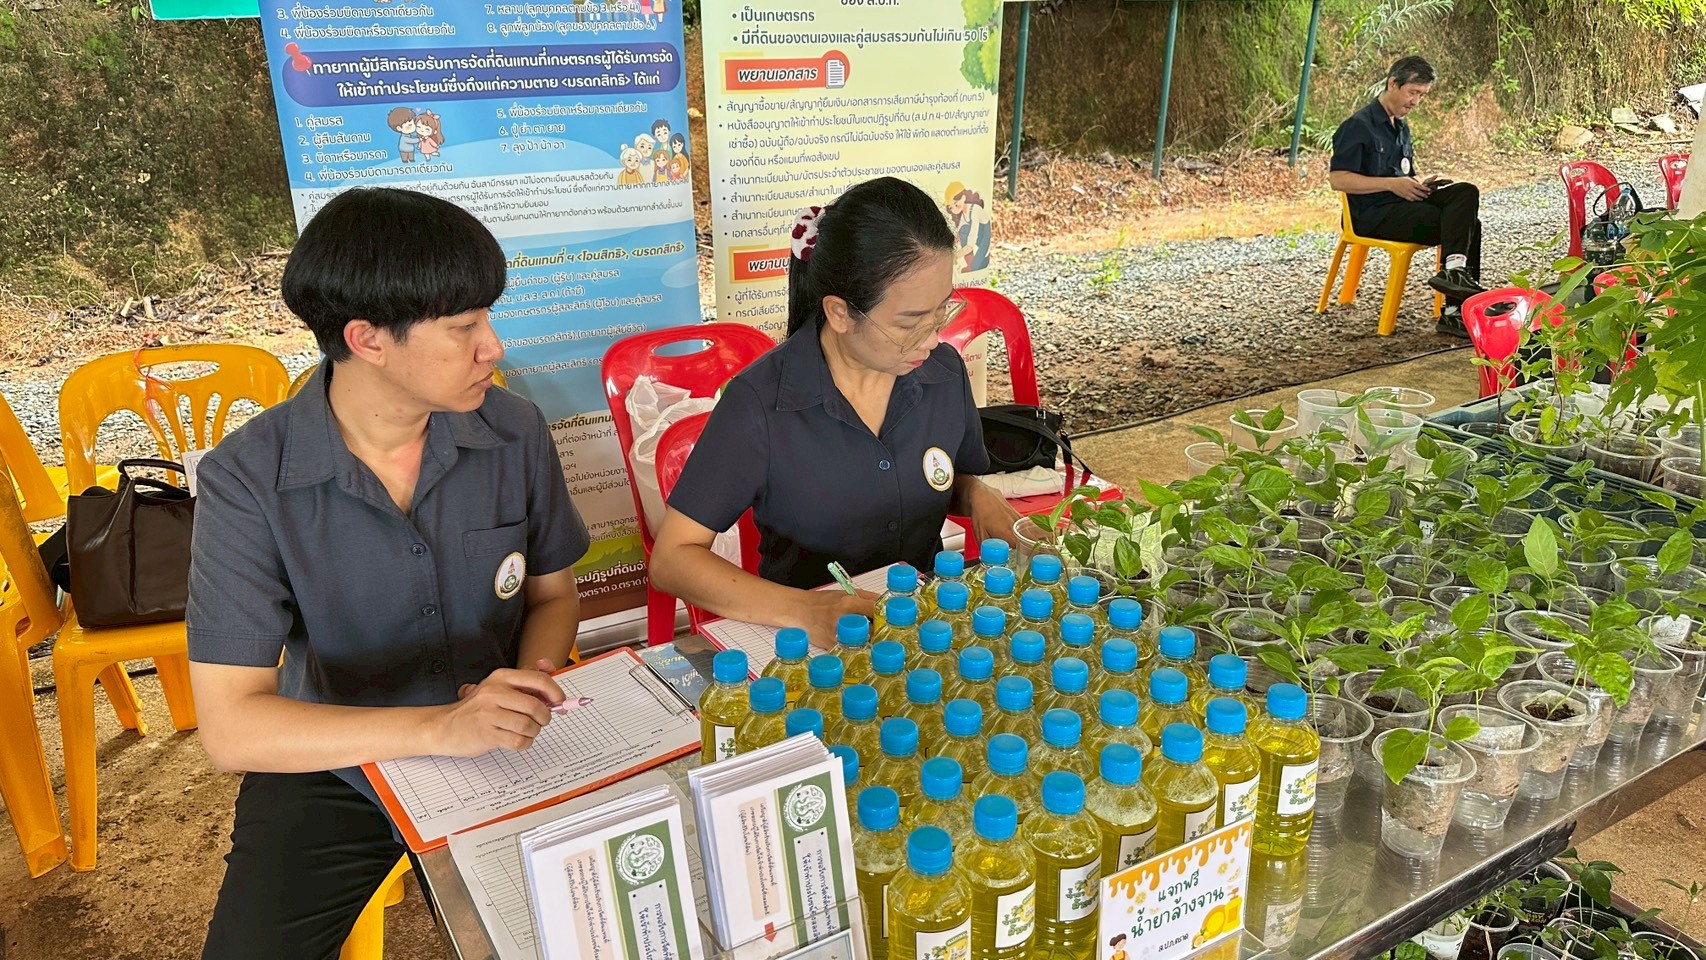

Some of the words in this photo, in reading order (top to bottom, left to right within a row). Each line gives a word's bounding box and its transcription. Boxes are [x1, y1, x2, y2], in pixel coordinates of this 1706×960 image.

[277, 9, 289, 19] 3.
[291, 2, 434, 19] พี่น้องร่วมบิดามารดาเดียวกัน
[485, 4, 495, 14] 7.
[497, 4, 523, 15] หลาน
[741, 6, 815, 22] เป็นเกษตรกร
[280, 28, 291, 38] 4.
[294, 22, 456, 38] พี่น้องร่วมบิดาหรือมารดาเดียวกัน
[487, 23, 498, 33] 8.
[500, 16, 554, 36] ลูกพี่ลูกน้อง
[742, 25, 961, 49] มีที่ดินของตนเองและคู่สมรสรวมกันไม่เกิน
[965, 31, 976, 40] 50
[980, 28, 988, 40] ไร่
[313, 47, 673, 78] ทายาทผู้มีสิทธิขอรับการจัดที่ดินแทนที่เกษตรกรผู้ได้รับการจัด
[739, 69, 817, 81] พยานเอกสาร
[336, 73, 558, 98] ให้เข้าทำประโยชน์ซึ่งถึงแก่ความตาย
[561, 74, 631, 89] <มรดกสิทธิ>
[633, 71, 660, 85] ได้แก่
[509, 101, 648, 118] พี่น้องร่วมบิดาหรือมารดาเดียวกัน
[306, 115, 343, 133] คู่สมรส
[547, 124, 565, 133] ยาย
[299, 136, 309, 146] 2.
[313, 133, 371, 150] ผู้สืบสันดาน
[302, 154, 313, 164] 3.
[316, 150, 387, 164] บิดาหรือมารดา
[730, 152, 766, 167] ของที่ดิน
[318, 163, 453, 181] พี่น้องร่วมบิดามารดาเดียวกัน
[505, 248, 565, 269] ดที่ดินแทนที่
[749, 257, 790, 274] พยานบุ
[735, 287, 789, 304] ผู้ที่ได้รับการจั
[548, 413, 614, 431] รจัดที่ดินแทน
[554, 426, 612, 445] นที่ต่อเจ้าหน้าที่
[575, 560, 646, 584] ารปฏิรูปที่ดินจั
[1158, 869, 1199, 902] แจกฟรี
[1131, 887, 1224, 939] น้ำยาล้างจาน
